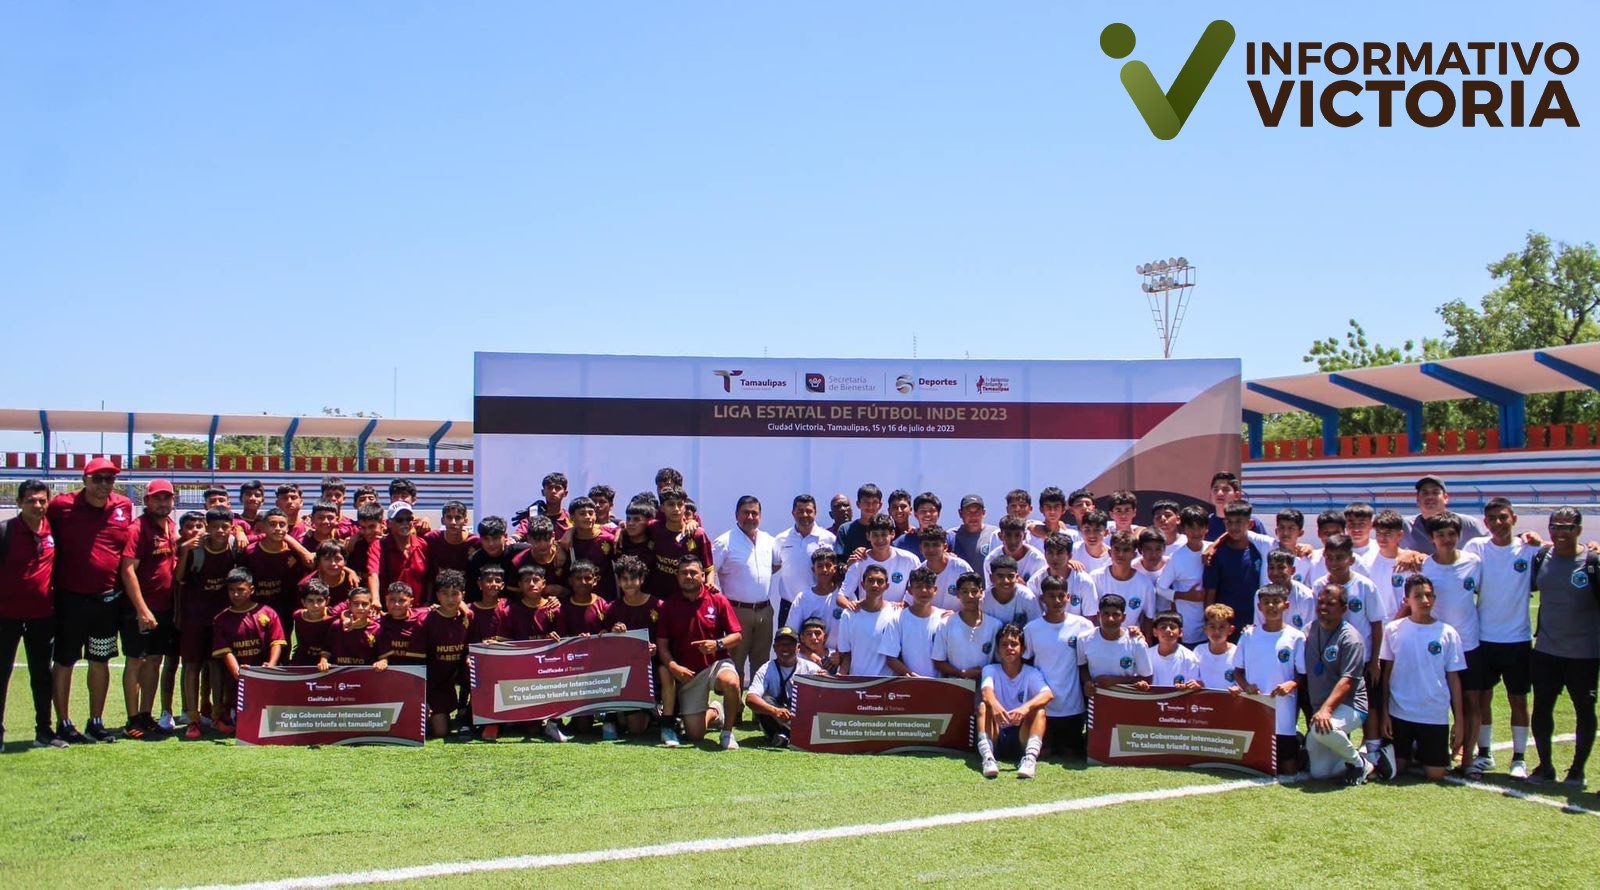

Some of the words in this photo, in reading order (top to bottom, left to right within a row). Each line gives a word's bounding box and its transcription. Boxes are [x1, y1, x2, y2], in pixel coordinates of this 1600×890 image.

[740, 378, 787, 388] Tamaulipas
[918, 378, 958, 387] Deportes
[840, 384, 876, 392] Bienestar
[714, 405, 752, 419] LIGA
[756, 405, 826, 419] ESTATAL
[830, 406, 852, 419] DE
[857, 404, 922, 420] FÚTBOL
[927, 407, 966, 420] INDE
[970, 407, 1008, 421] 2023
[767, 423, 793, 431] Ciudad
[794, 423, 826, 432] Victoria,
[827, 424, 870, 433] Tamaulipas,
[882, 425, 886, 433] y
[888, 424, 896, 432] 16
[898, 424, 908, 432] de
[908, 424, 924, 433] julio
[926, 424, 936, 432] de
[531, 682, 568, 691] Gobernador
[570, 677, 610, 687] Internacional
[522, 692, 546, 700] talento
[548, 690, 568, 698] triunfa
[888, 720, 930, 728] Internacional
[1132, 732, 1148, 740] Copa
[1150, 732, 1190, 741] Gobernador
[1191, 736, 1234, 745] Internacional
